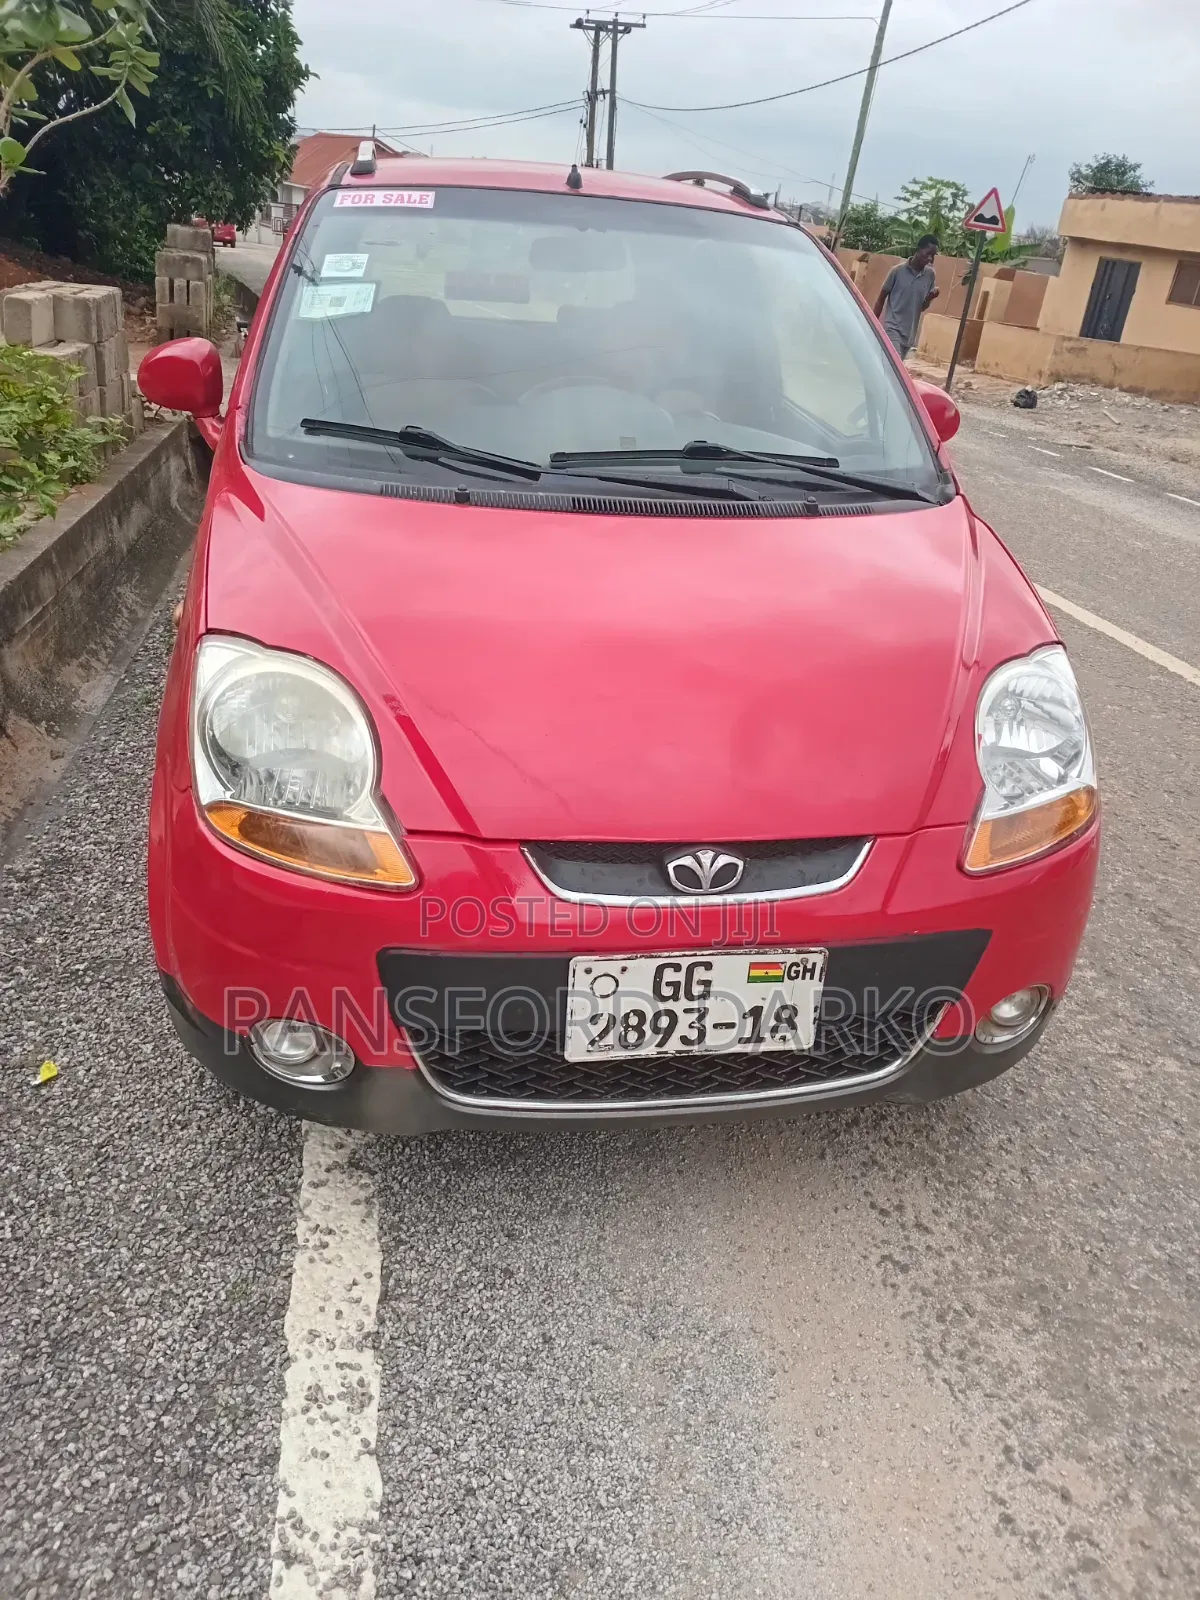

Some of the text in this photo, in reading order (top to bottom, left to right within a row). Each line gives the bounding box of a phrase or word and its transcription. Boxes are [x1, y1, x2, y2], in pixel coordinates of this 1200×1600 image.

[338, 193, 429, 205] FOR SALE
[652, 961, 713, 1003] GG
[786, 961, 817, 981] GH
[586, 1005, 799, 1053] 2893-18
